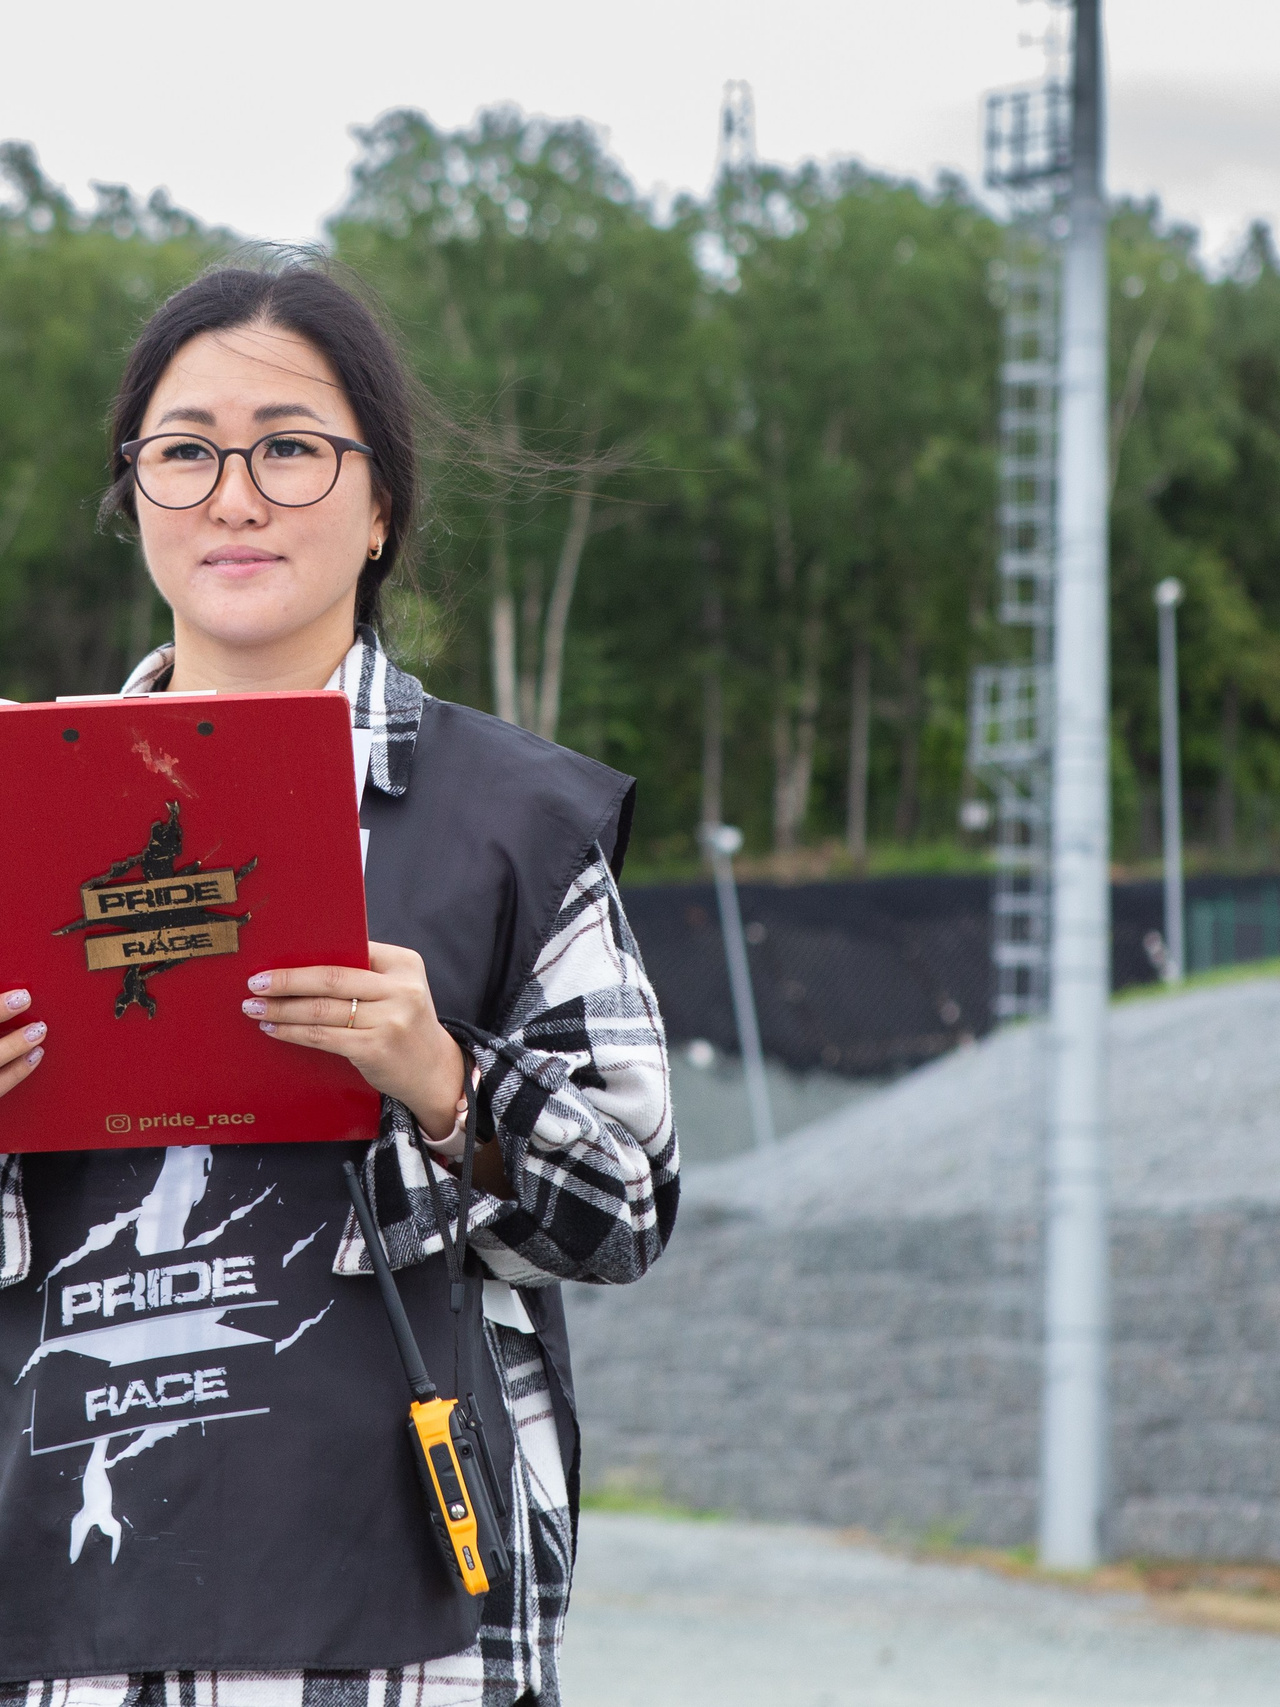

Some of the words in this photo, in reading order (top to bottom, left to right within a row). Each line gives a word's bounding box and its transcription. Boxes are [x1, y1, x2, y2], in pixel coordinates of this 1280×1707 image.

[97, 881, 222, 914] PRIDE
[122, 933, 214, 958] RACE
[139, 1113, 256, 1131] pride_race
[61, 1255, 257, 1326] PRIDE
[85, 1367, 230, 1421] RACE
